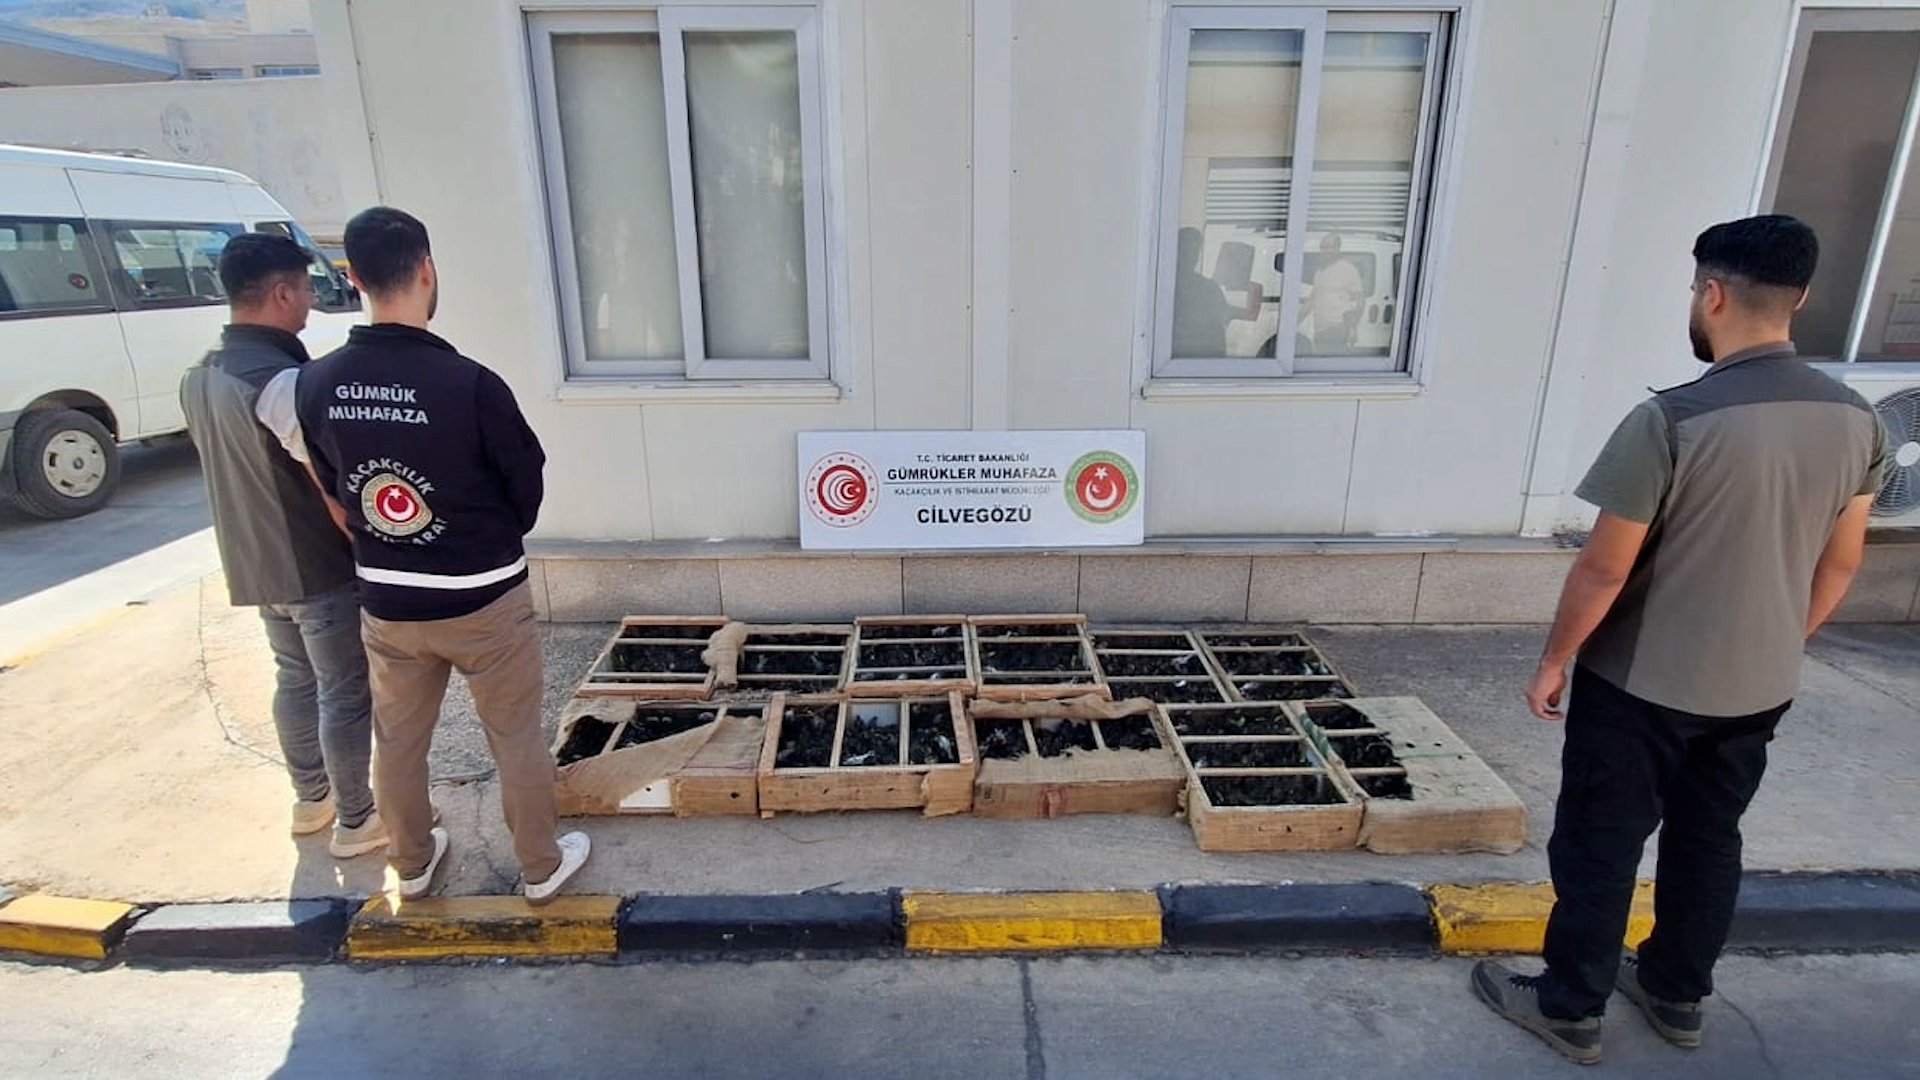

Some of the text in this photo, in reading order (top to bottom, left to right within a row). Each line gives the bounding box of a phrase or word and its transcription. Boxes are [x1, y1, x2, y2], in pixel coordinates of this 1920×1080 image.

[335, 382, 417, 403] GÜMRÜK
[328, 405, 430, 425] MUHAFAZA
[916, 452, 1030, 463] T.C. TİCARET BAKANLIĞI
[346, 457, 436, 495] KAÇAKÇILIK
[887, 466, 1057, 480] GÜMRÜKLER MUHAFAZA
[943, 487, 952, 495] VE
[917, 504, 1032, 524] CİLVEGÖZÜ
